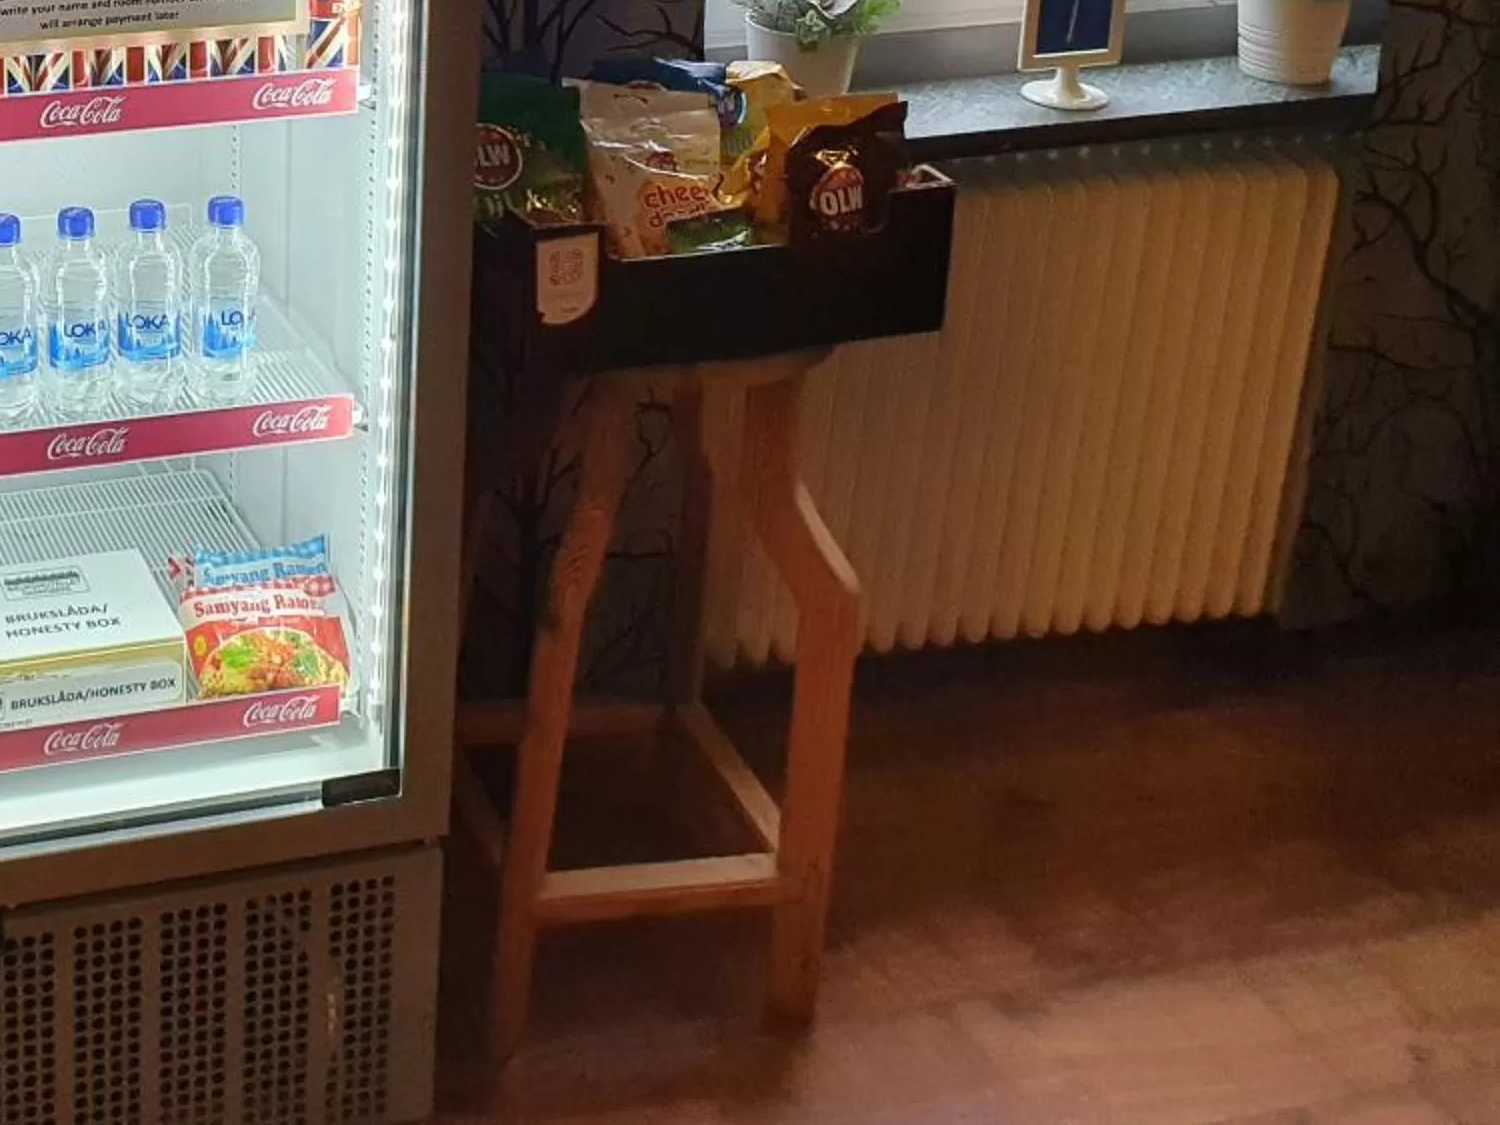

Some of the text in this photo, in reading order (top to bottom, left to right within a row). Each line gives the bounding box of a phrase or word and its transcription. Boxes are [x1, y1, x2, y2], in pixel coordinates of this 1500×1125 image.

[38, 89, 127, 129] Coca-Cola
[252, 76, 337, 109] Coca-Cola
[820, 190, 864, 216] OLW
[125, 313, 170, 330] LOKA
[251, 404, 335, 437] Coca-Cola
[47, 427, 132, 460] Coca-Cola
[4, 602, 109, 624] BRUKSLÅDA/
[193, 595, 271, 618] Samyang
[4, 616, 122, 639] HONESTY BOX
[11, 676, 177, 711] BRUKSLÅDA/HONESTY BOX
[243, 694, 322, 727] Coca-Cola
[42, 721, 127, 756] Coca-Cola
